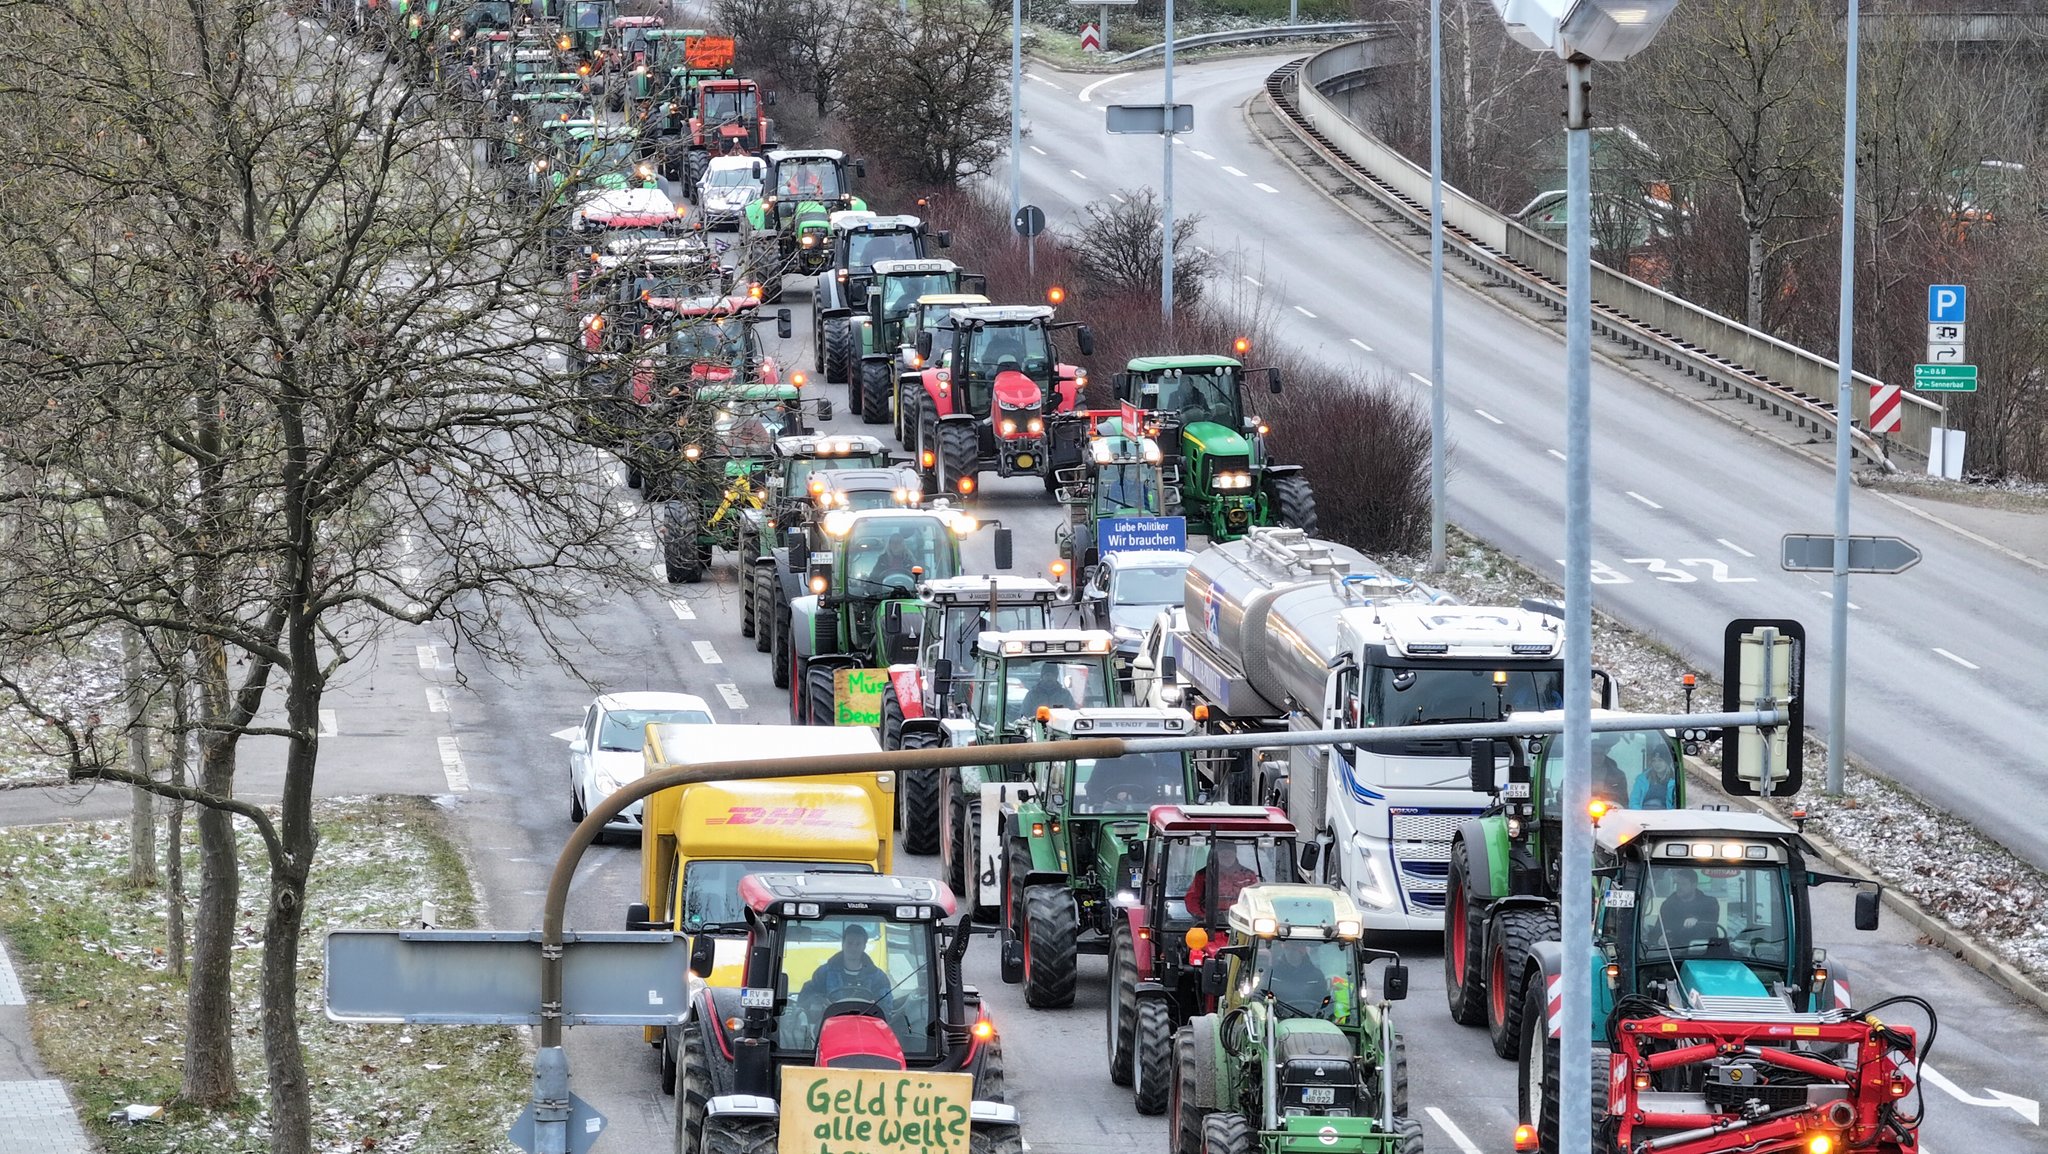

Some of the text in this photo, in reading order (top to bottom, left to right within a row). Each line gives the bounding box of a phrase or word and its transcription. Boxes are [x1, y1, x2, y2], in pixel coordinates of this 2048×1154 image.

[1936, 289, 1958, 318] P
[1115, 522, 1169, 532] Liebe Politiker
[1108, 533, 1176, 546] Wir brauchen
[726, 807, 833, 826] DHL
[806, 1078, 947, 1116] Geld für
[813, 1116, 873, 1142] alle
